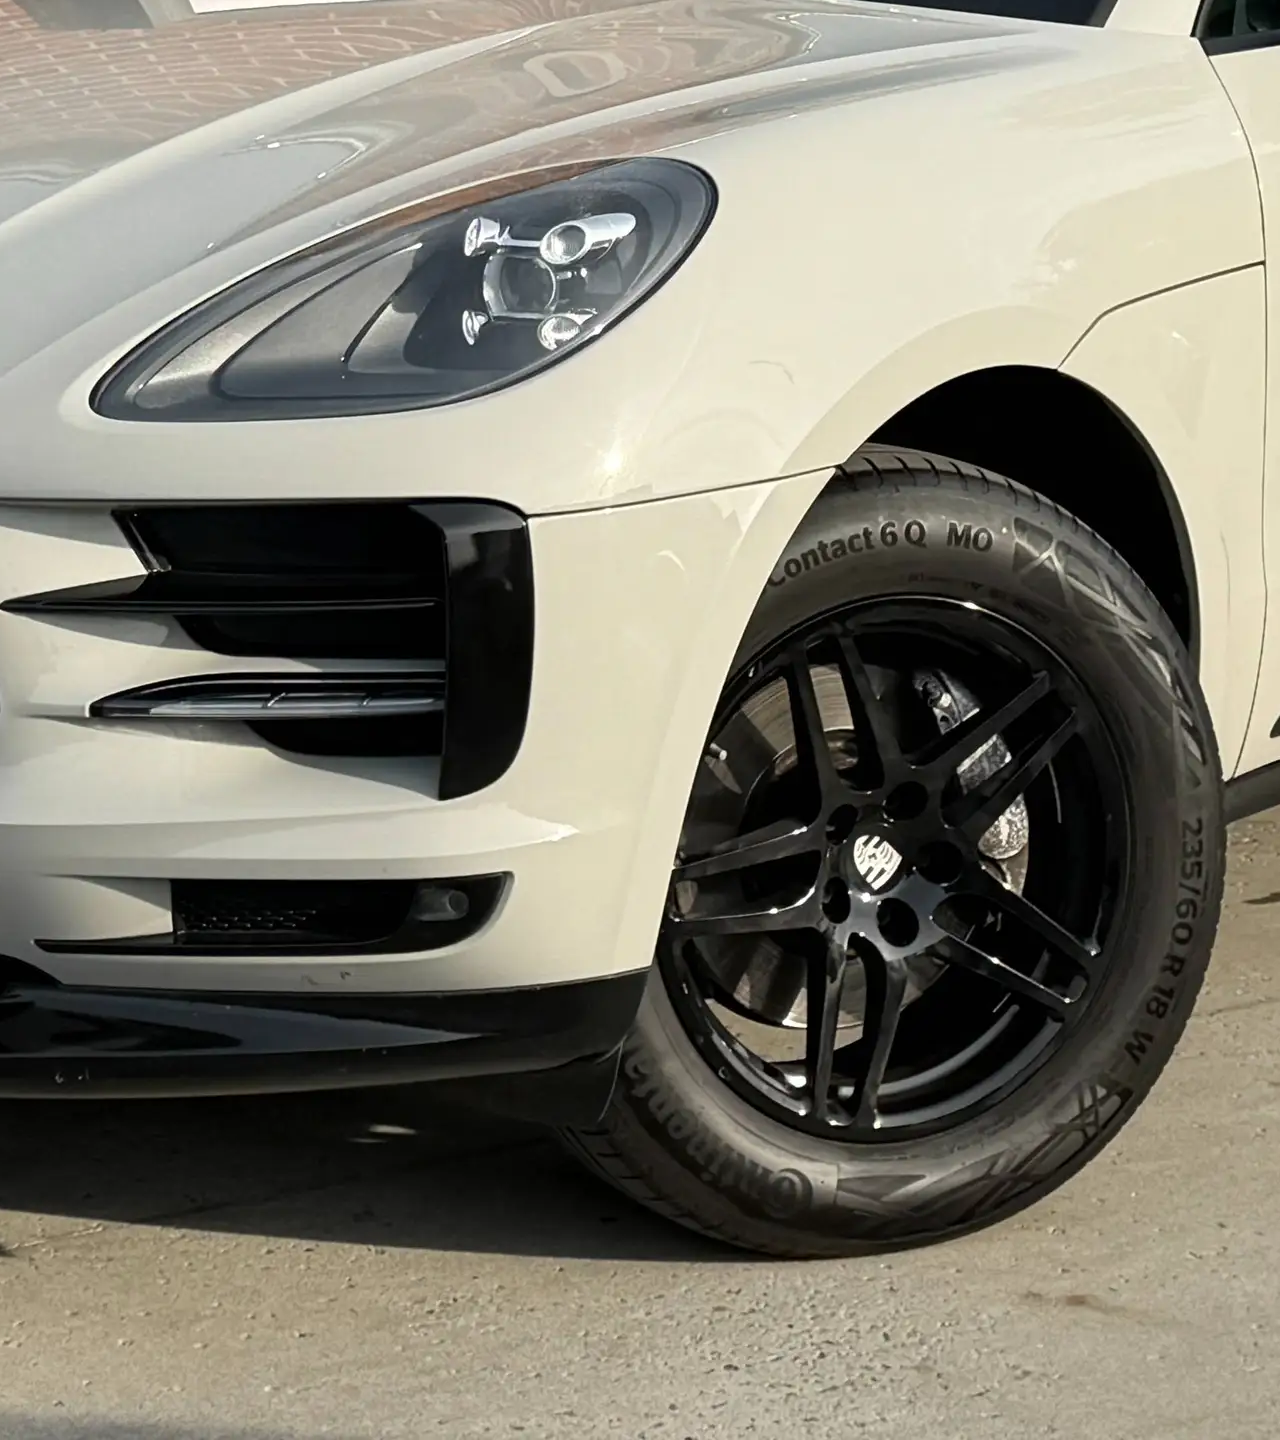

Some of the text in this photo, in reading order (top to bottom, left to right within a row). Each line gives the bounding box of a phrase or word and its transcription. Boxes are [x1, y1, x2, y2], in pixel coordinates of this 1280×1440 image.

[946, 520, 995, 553] MO
[1123, 816, 1204, 1065] 235/60 R 18 W
